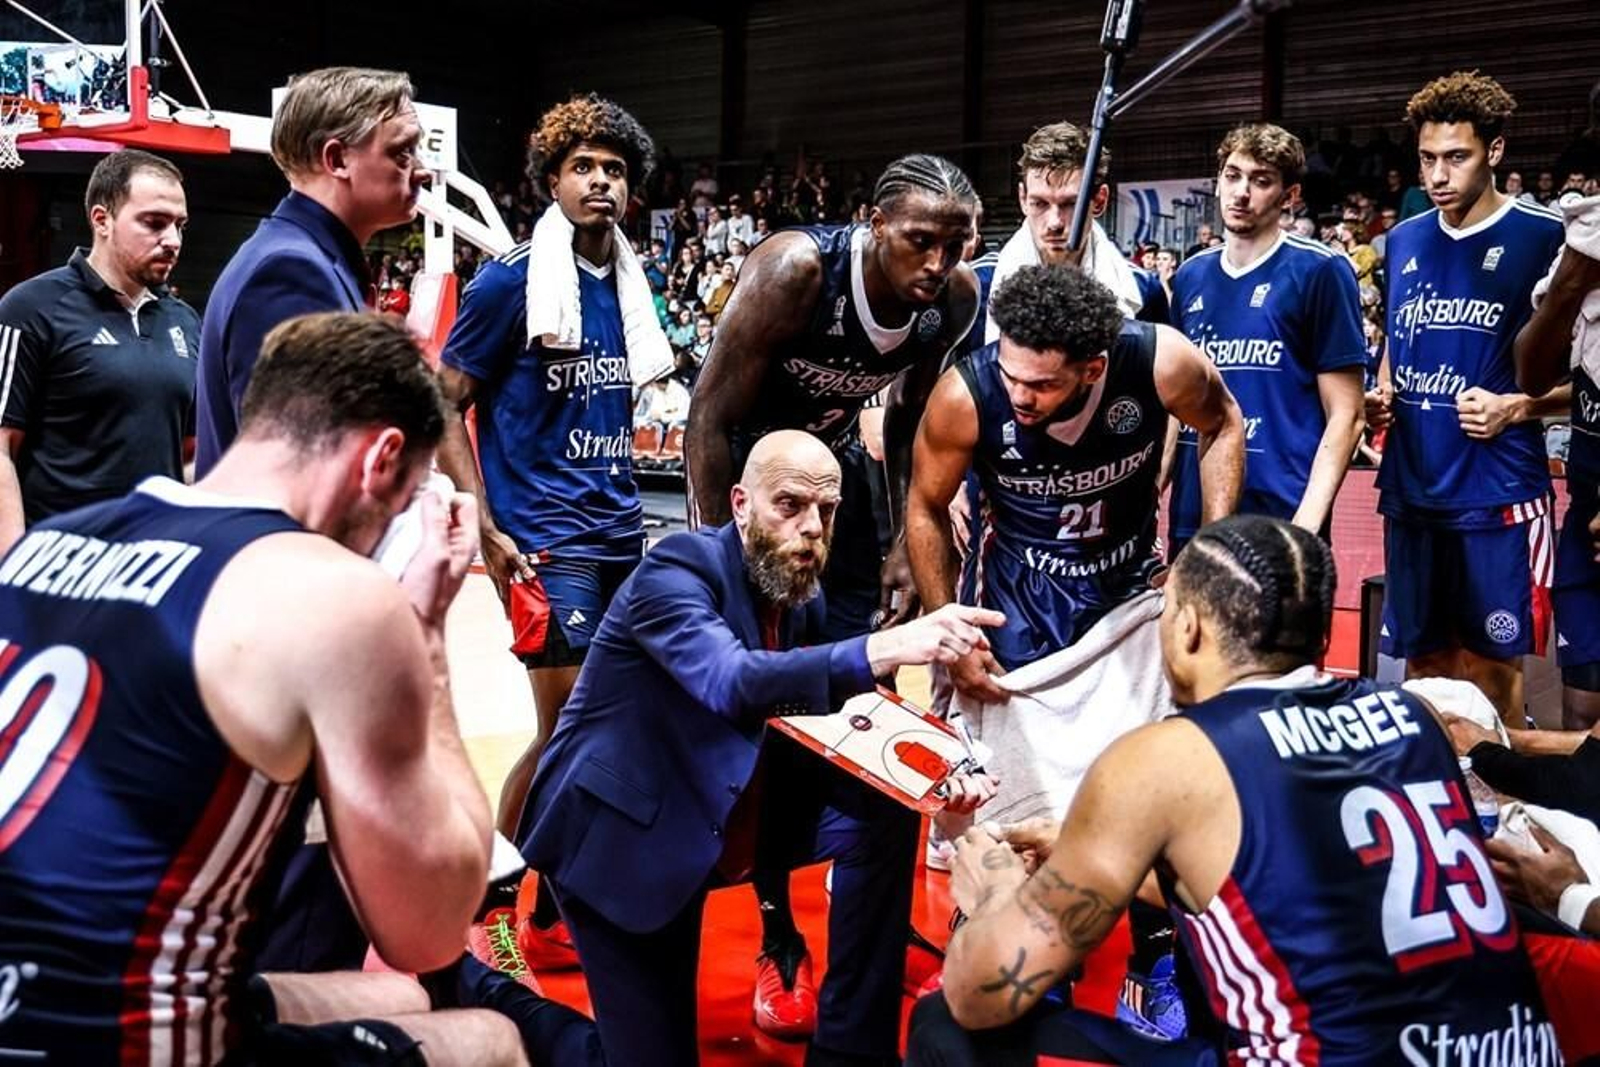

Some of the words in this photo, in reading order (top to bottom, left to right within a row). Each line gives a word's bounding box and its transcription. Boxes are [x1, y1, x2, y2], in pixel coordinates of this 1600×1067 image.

[783, 358, 898, 393] STRASBO
[806, 408, 845, 431] 3
[565, 426, 632, 460] Stradi
[1056, 500, 1105, 540] 21
[0, 639, 102, 848] 0
[1258, 690, 1421, 759] MCGEE
[1340, 780, 1512, 960] 25
